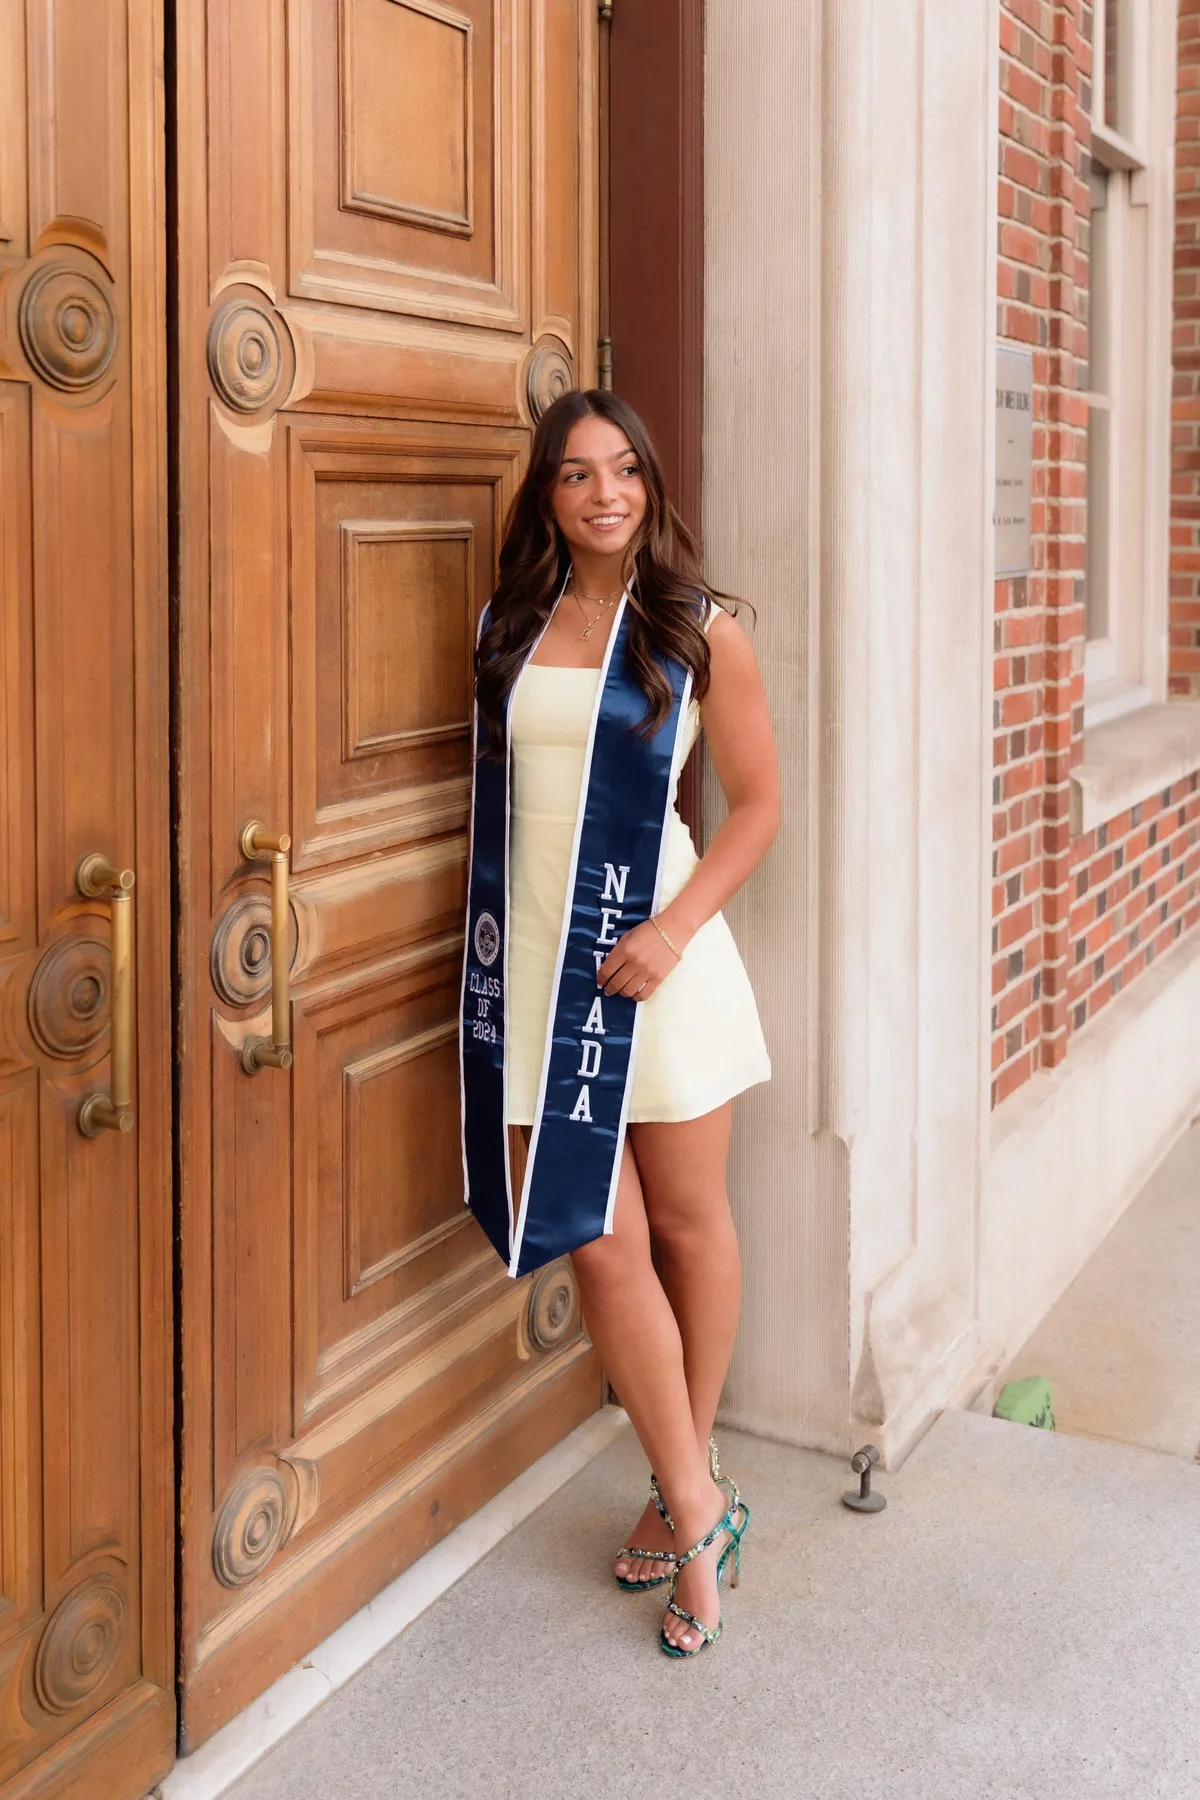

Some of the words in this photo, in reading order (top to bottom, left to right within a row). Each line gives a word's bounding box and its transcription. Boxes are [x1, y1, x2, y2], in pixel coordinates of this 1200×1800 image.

[469, 972, 500, 998] CLASS
[477, 998, 490, 1017] OF
[472, 1019, 497, 1044] 2024
